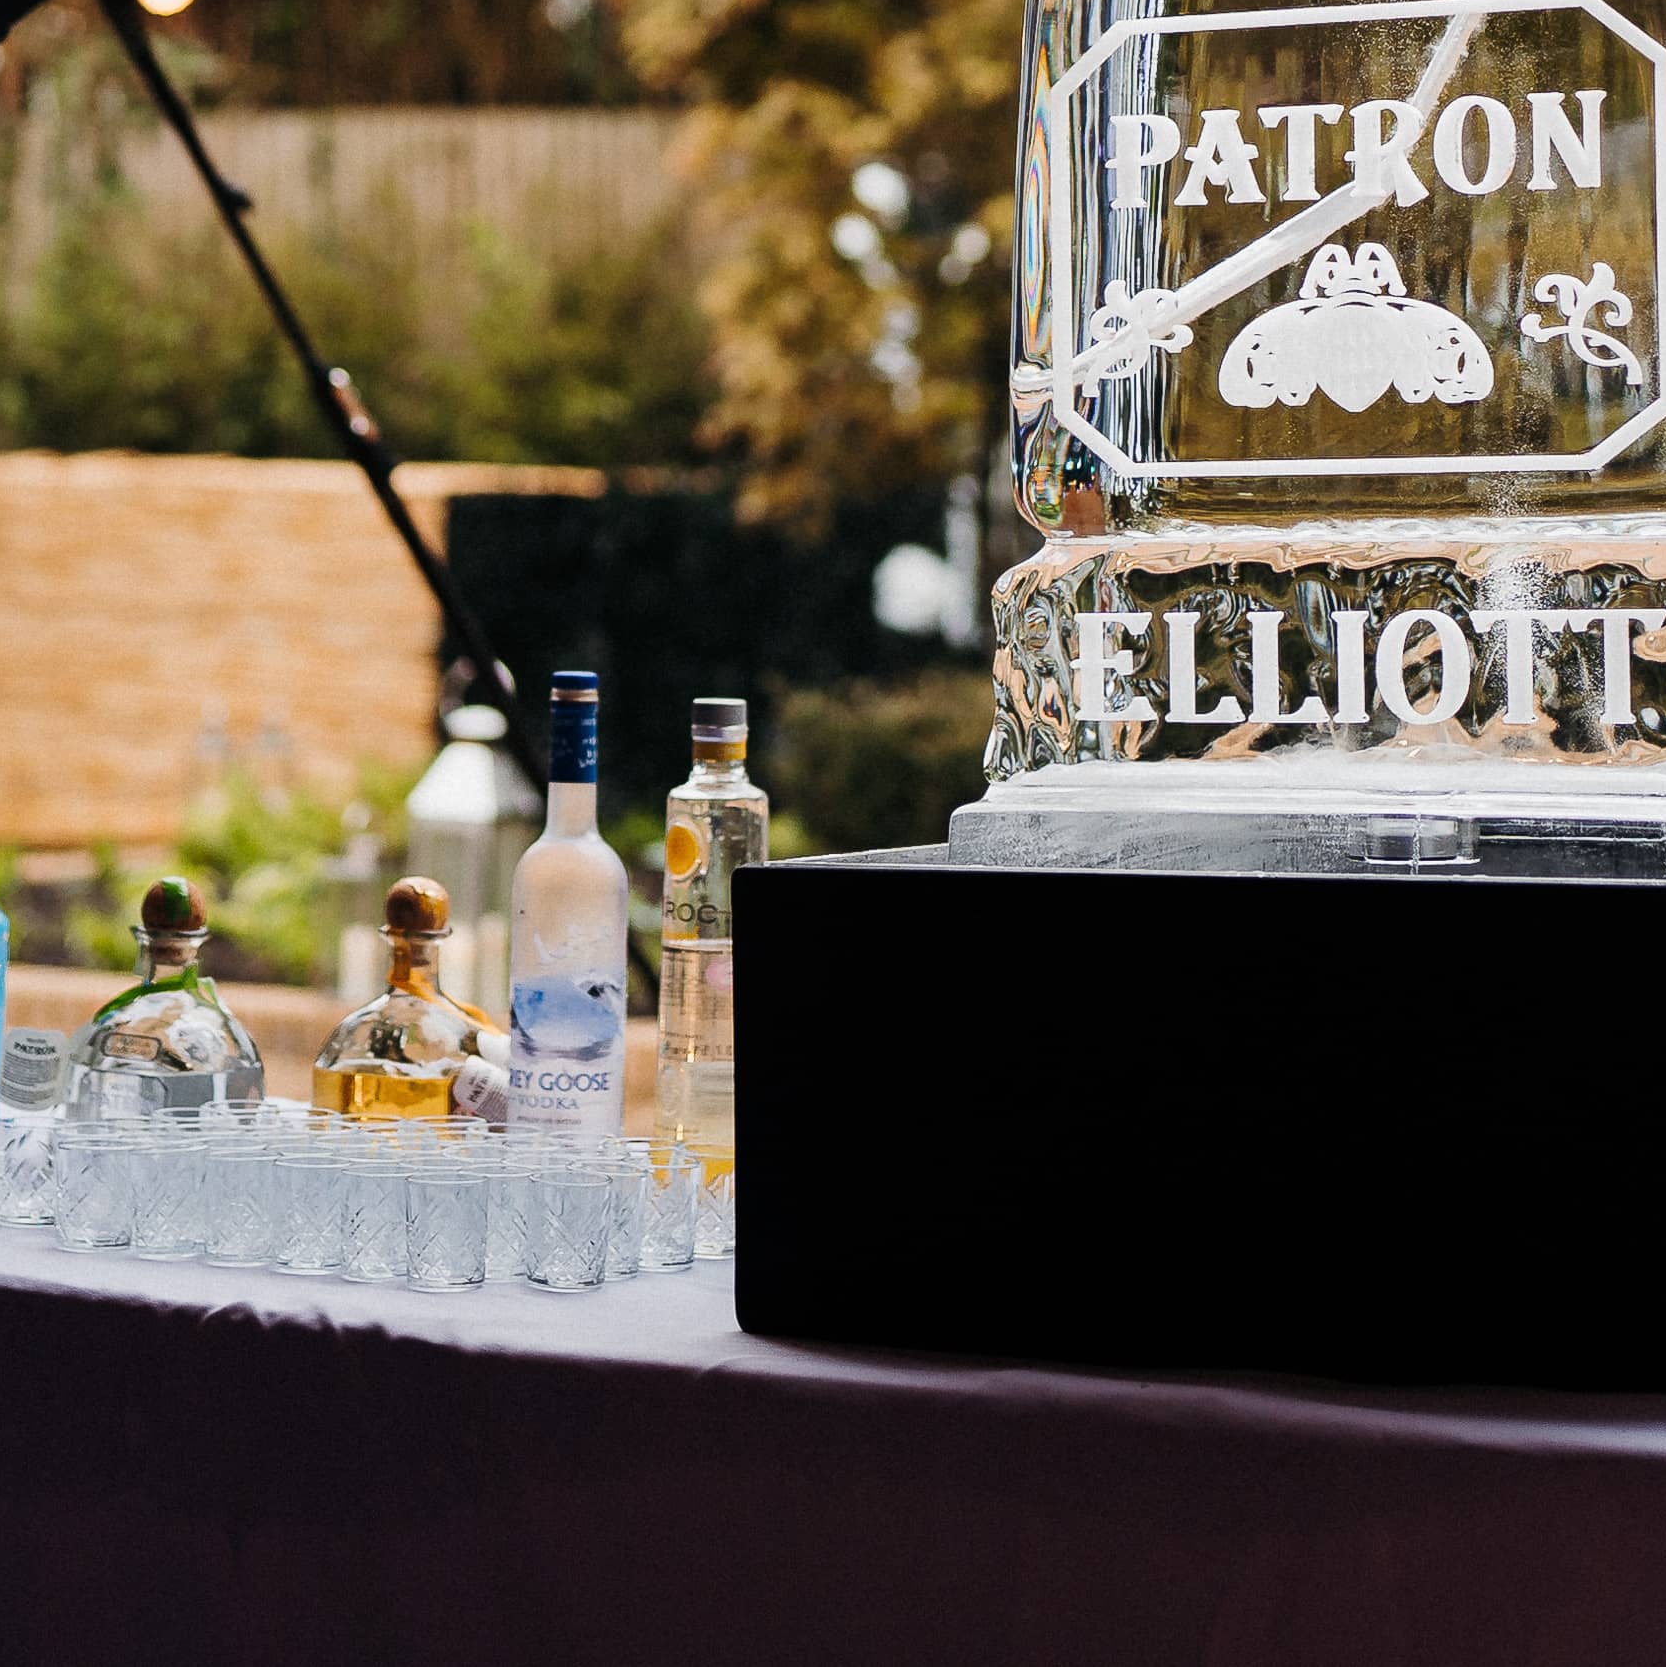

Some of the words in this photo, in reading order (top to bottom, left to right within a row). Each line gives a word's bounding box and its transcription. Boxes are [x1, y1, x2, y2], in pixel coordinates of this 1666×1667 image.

[1104, 89, 1608, 210] PATRON
[664, 900, 719, 924] ROC
[538, 1071, 611, 1092] GOOSE
[517, 1094, 581, 1110] VODKA
